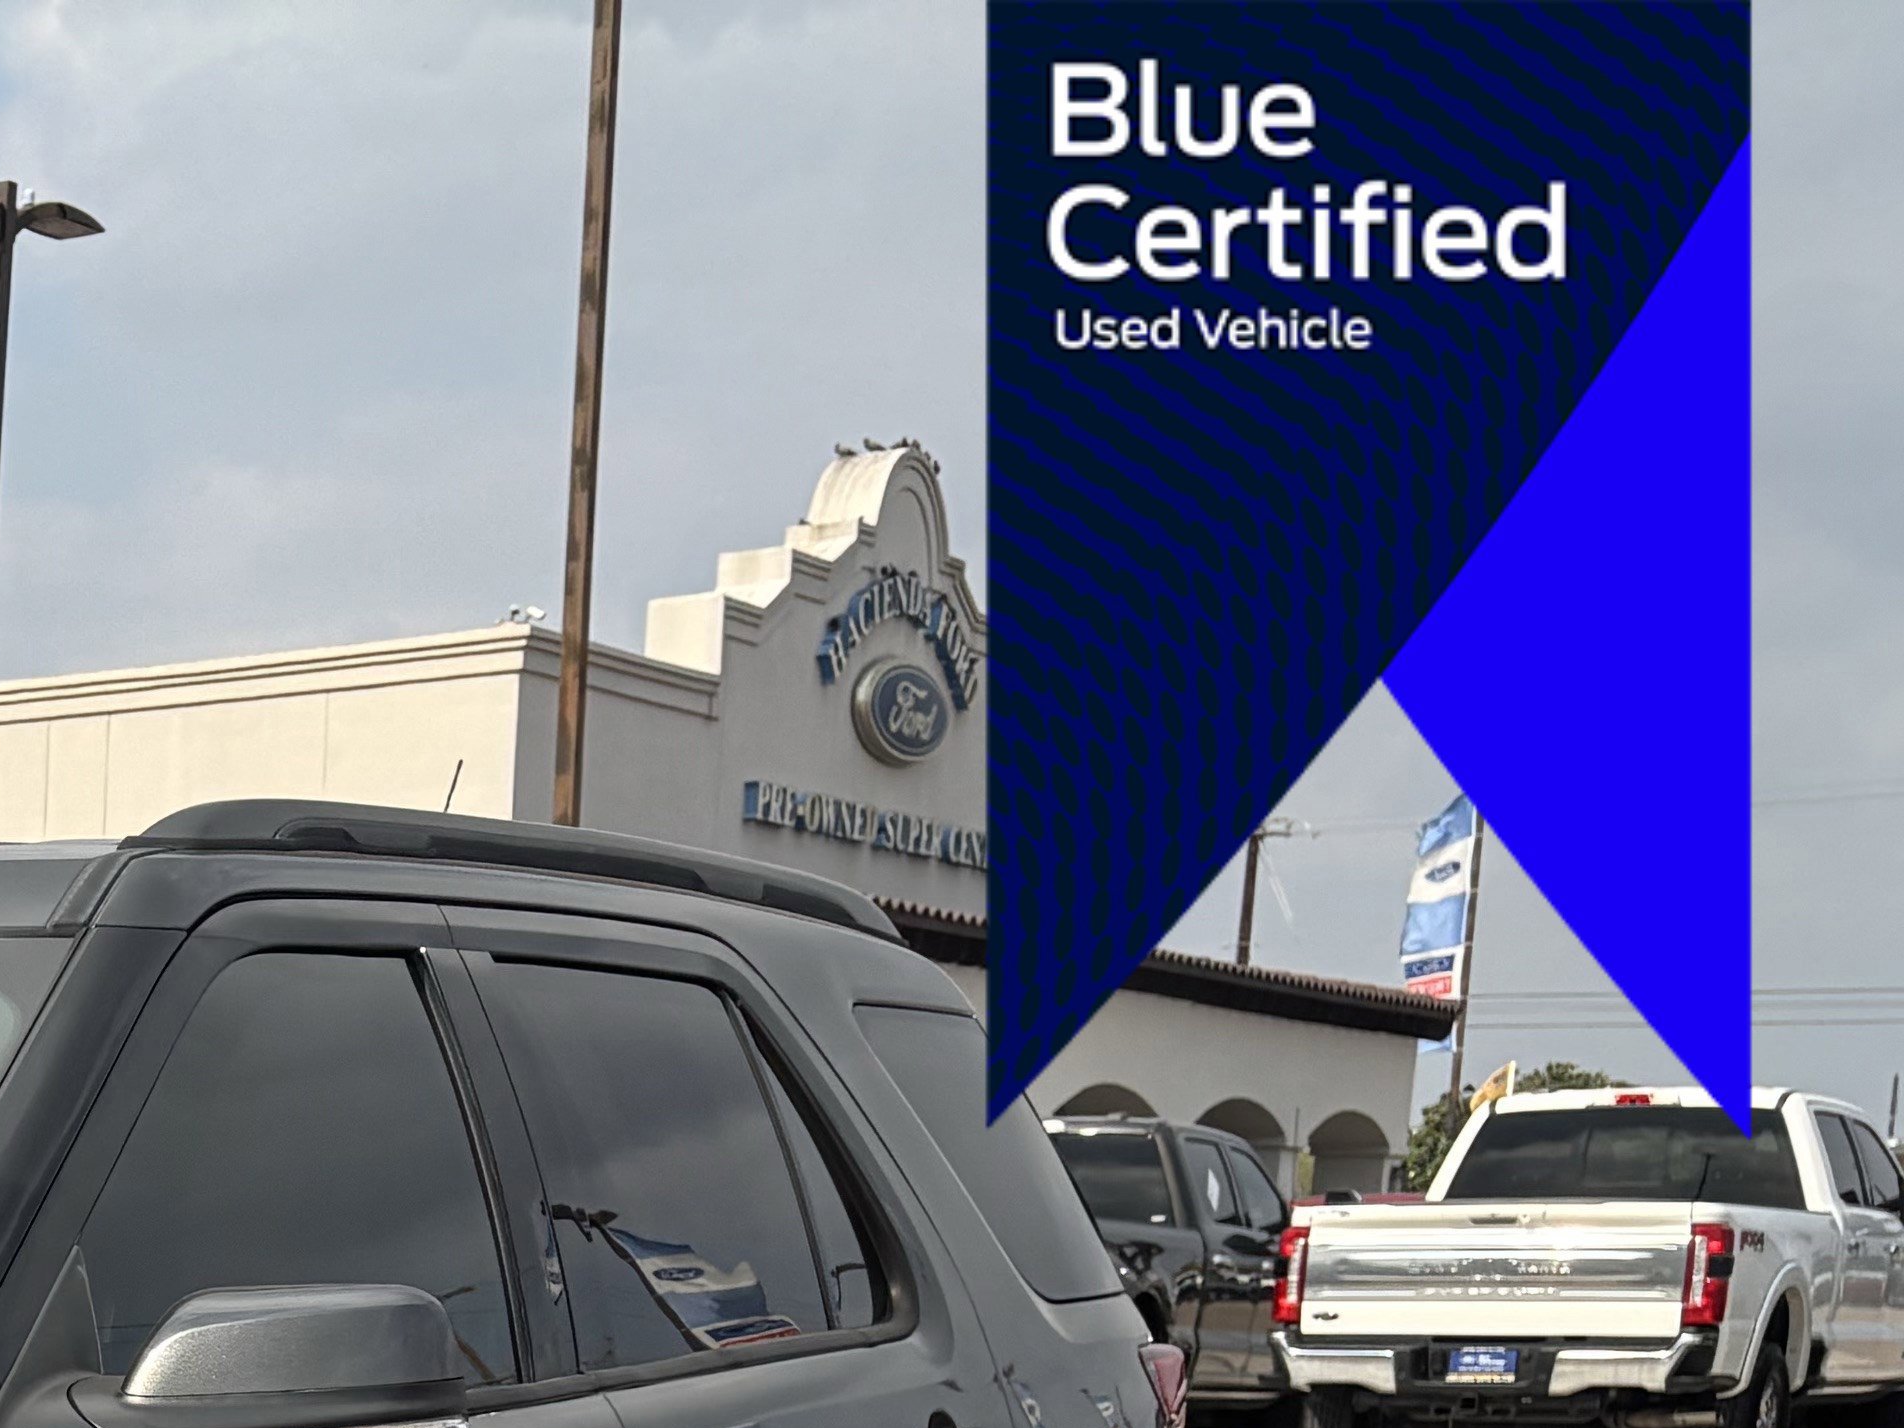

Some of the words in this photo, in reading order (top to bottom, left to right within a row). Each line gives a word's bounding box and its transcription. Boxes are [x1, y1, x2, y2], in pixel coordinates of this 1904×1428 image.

[826, 576, 937, 680] HACIENDA
[888, 680, 938, 742] Ford
[755, 779, 879, 845] PRE-OWNED
[882, 811, 943, 859] SUPER
